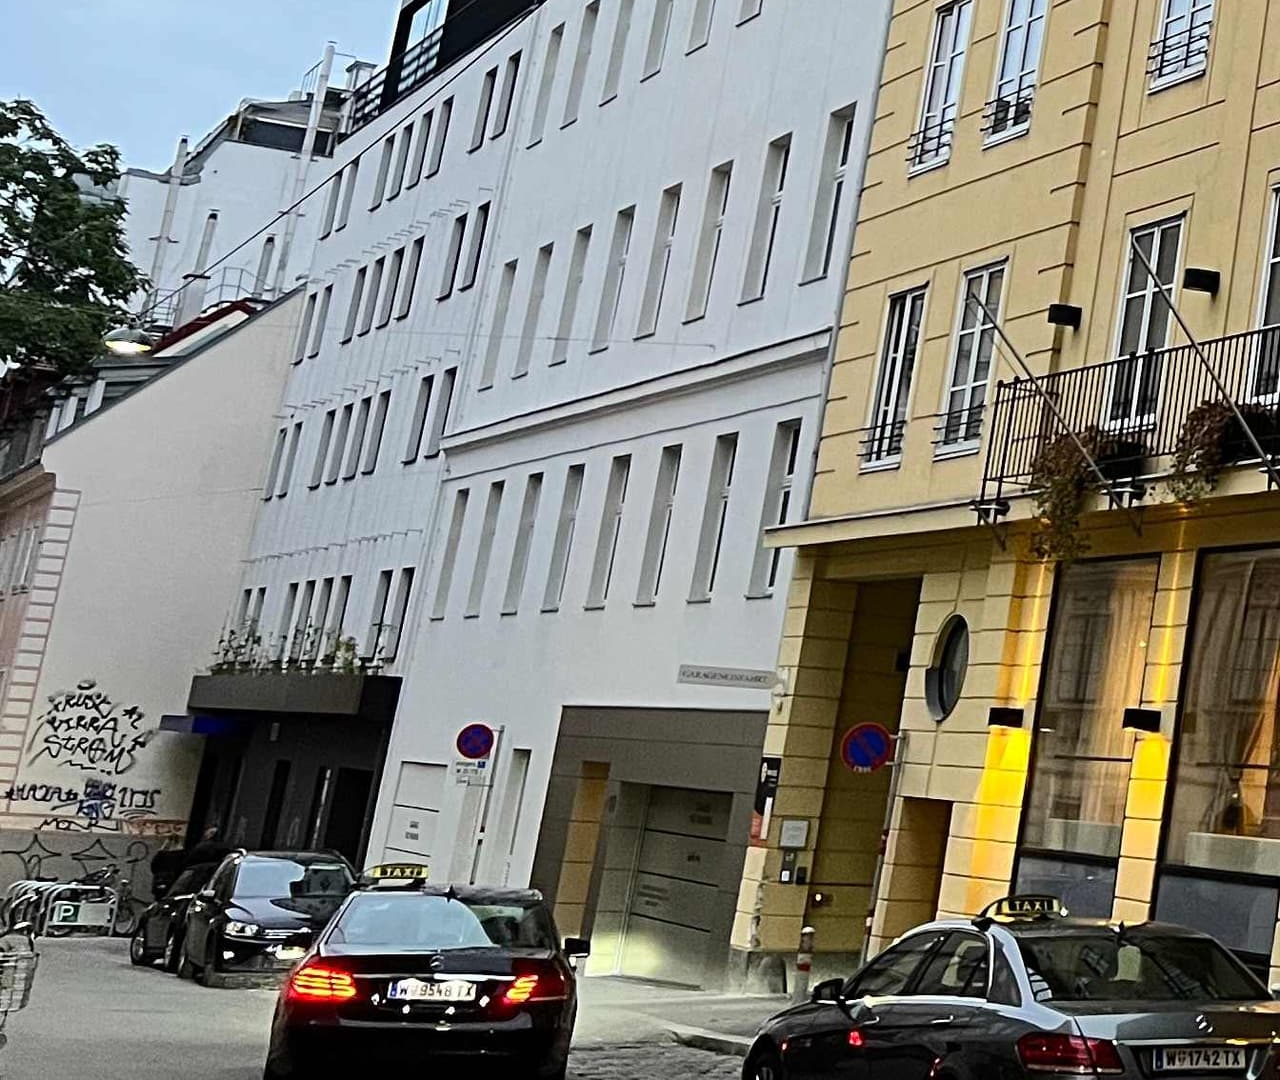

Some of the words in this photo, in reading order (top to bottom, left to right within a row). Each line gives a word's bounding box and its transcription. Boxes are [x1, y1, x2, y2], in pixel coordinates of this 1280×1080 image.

[387, 867, 418, 877] TAXI
[60, 905, 74, 920] P
[1014, 901, 1048, 912] TAXI
[1166, 1051, 1176, 1066] W
[1189, 1051, 1220, 1066] 1742
[1224, 1051, 1240, 1066] TX
